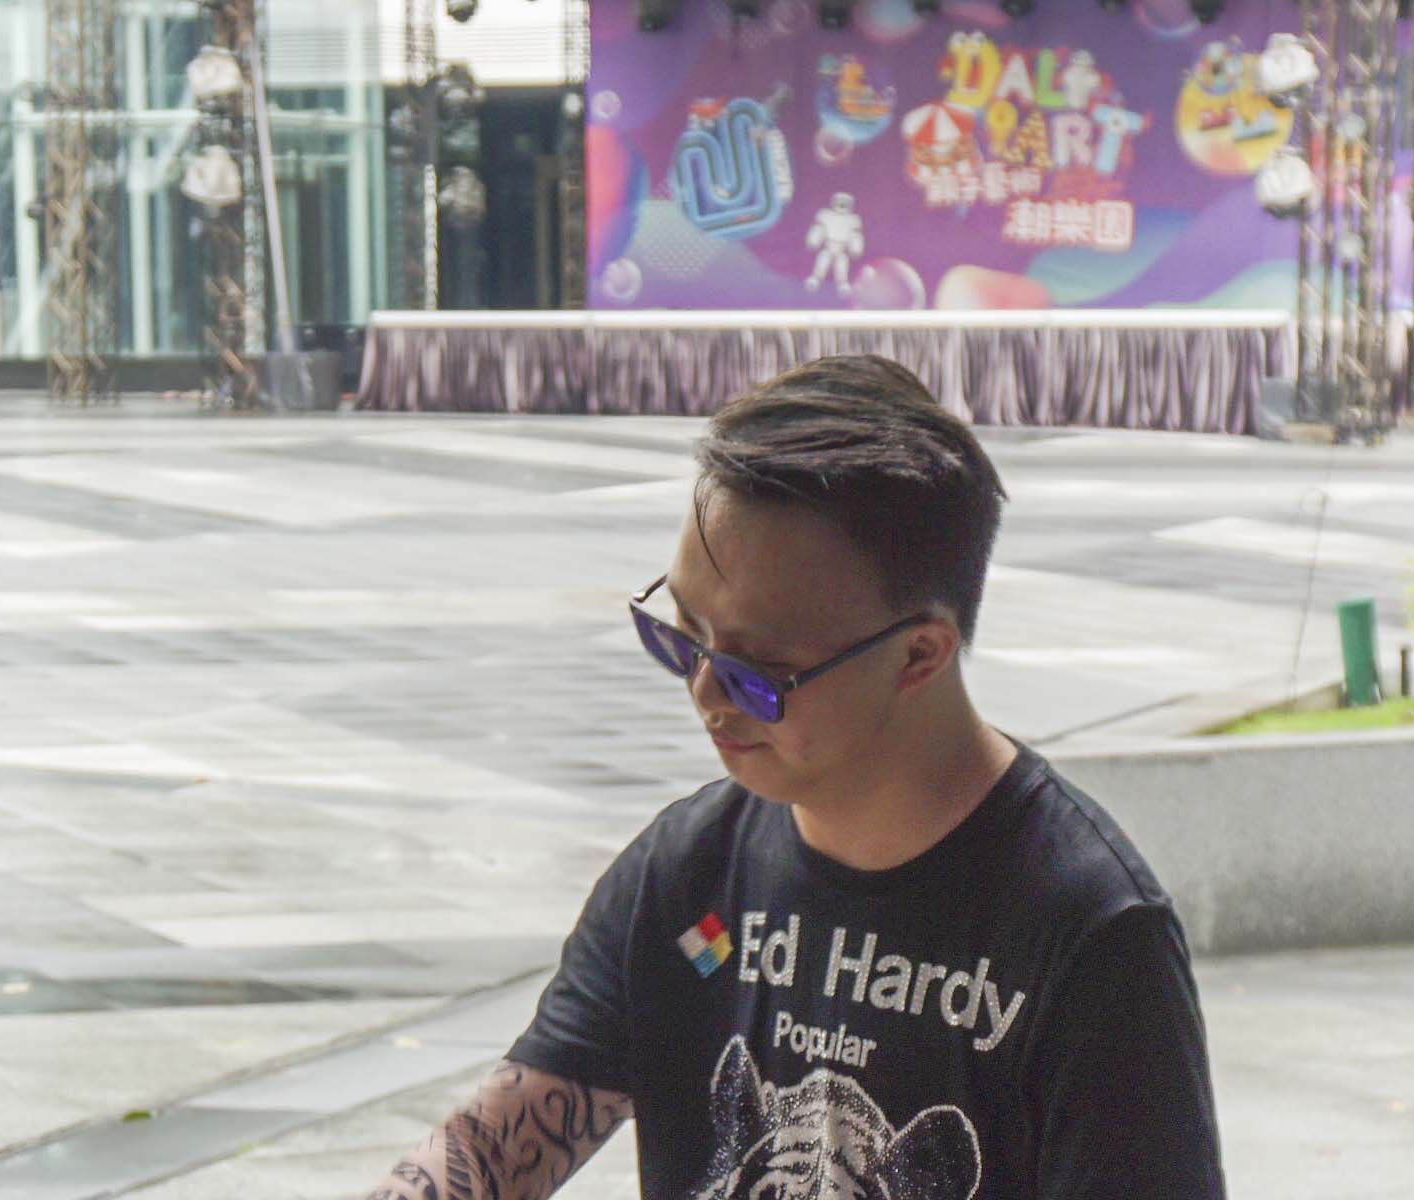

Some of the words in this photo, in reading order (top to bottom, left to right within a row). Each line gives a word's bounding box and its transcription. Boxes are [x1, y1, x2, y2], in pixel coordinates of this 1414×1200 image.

[738, 910, 801, 988] Ed
[822, 926, 1027, 1052] Hardy
[772, 1010, 878, 1069] Popular
